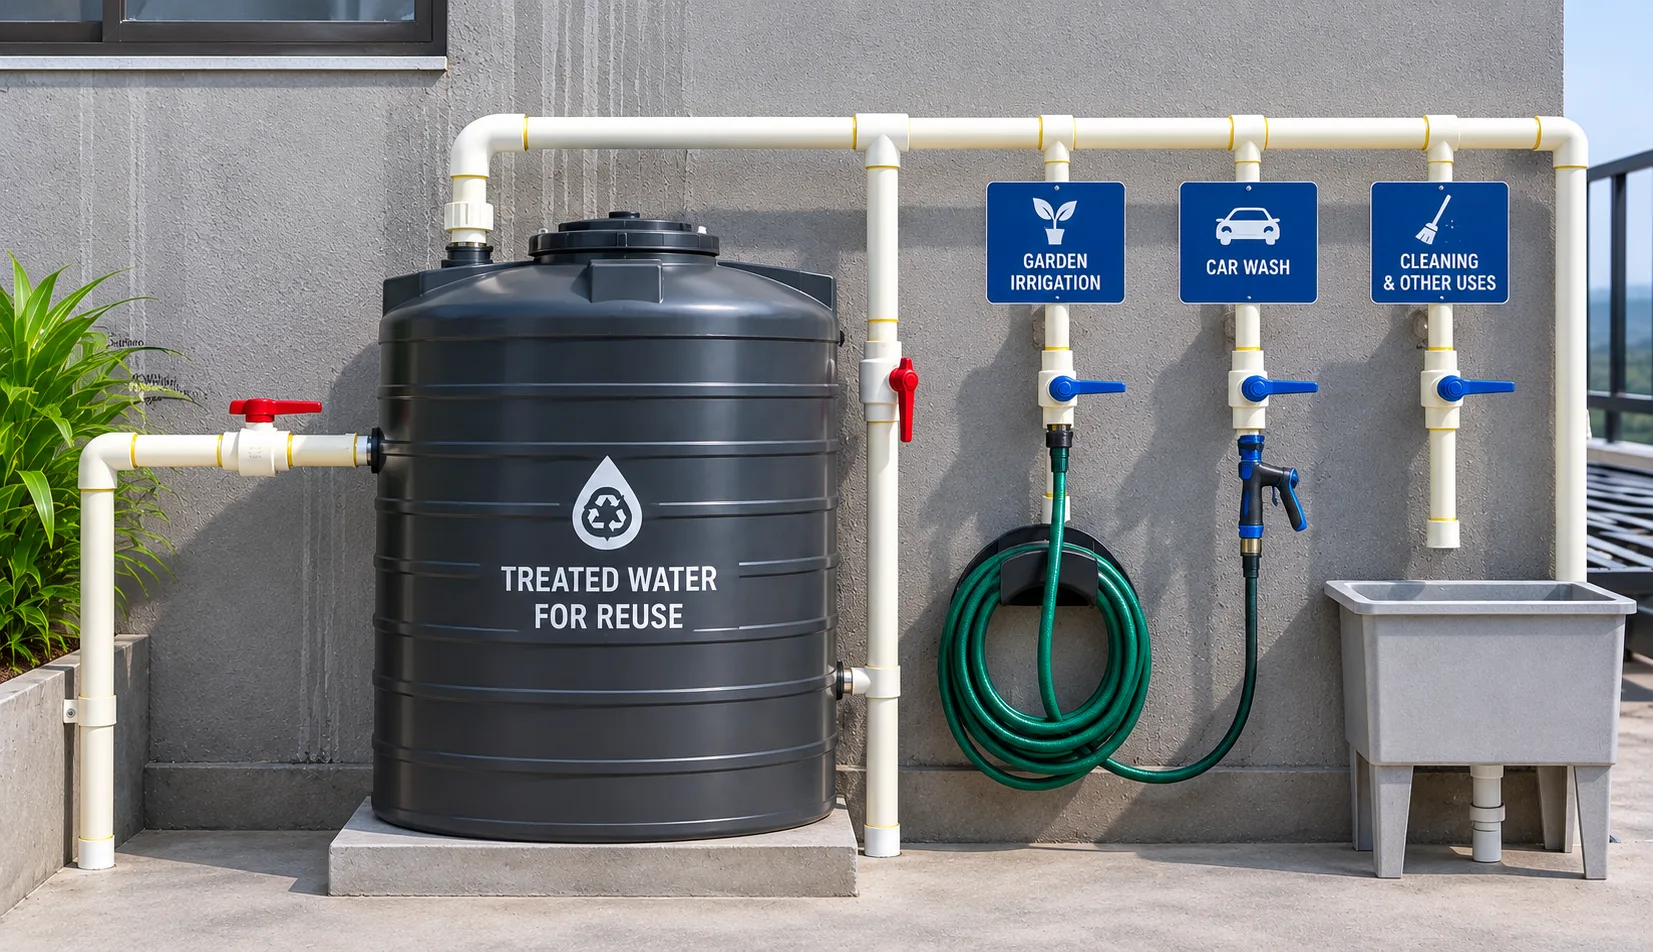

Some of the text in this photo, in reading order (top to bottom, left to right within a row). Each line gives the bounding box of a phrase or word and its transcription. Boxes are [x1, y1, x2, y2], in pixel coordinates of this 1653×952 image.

[1023, 252, 1088, 269] GARDEN
[1206, 258, 1290, 275] CAR WASH
[1400, 253, 1479, 269] CLEANING
[1010, 274, 1101, 291] IRRIGATION
[1383, 274, 1497, 291] & OTHER USES
[501, 565, 718, 592] TREATED WATER
[535, 603, 684, 630] FOR REUSE
